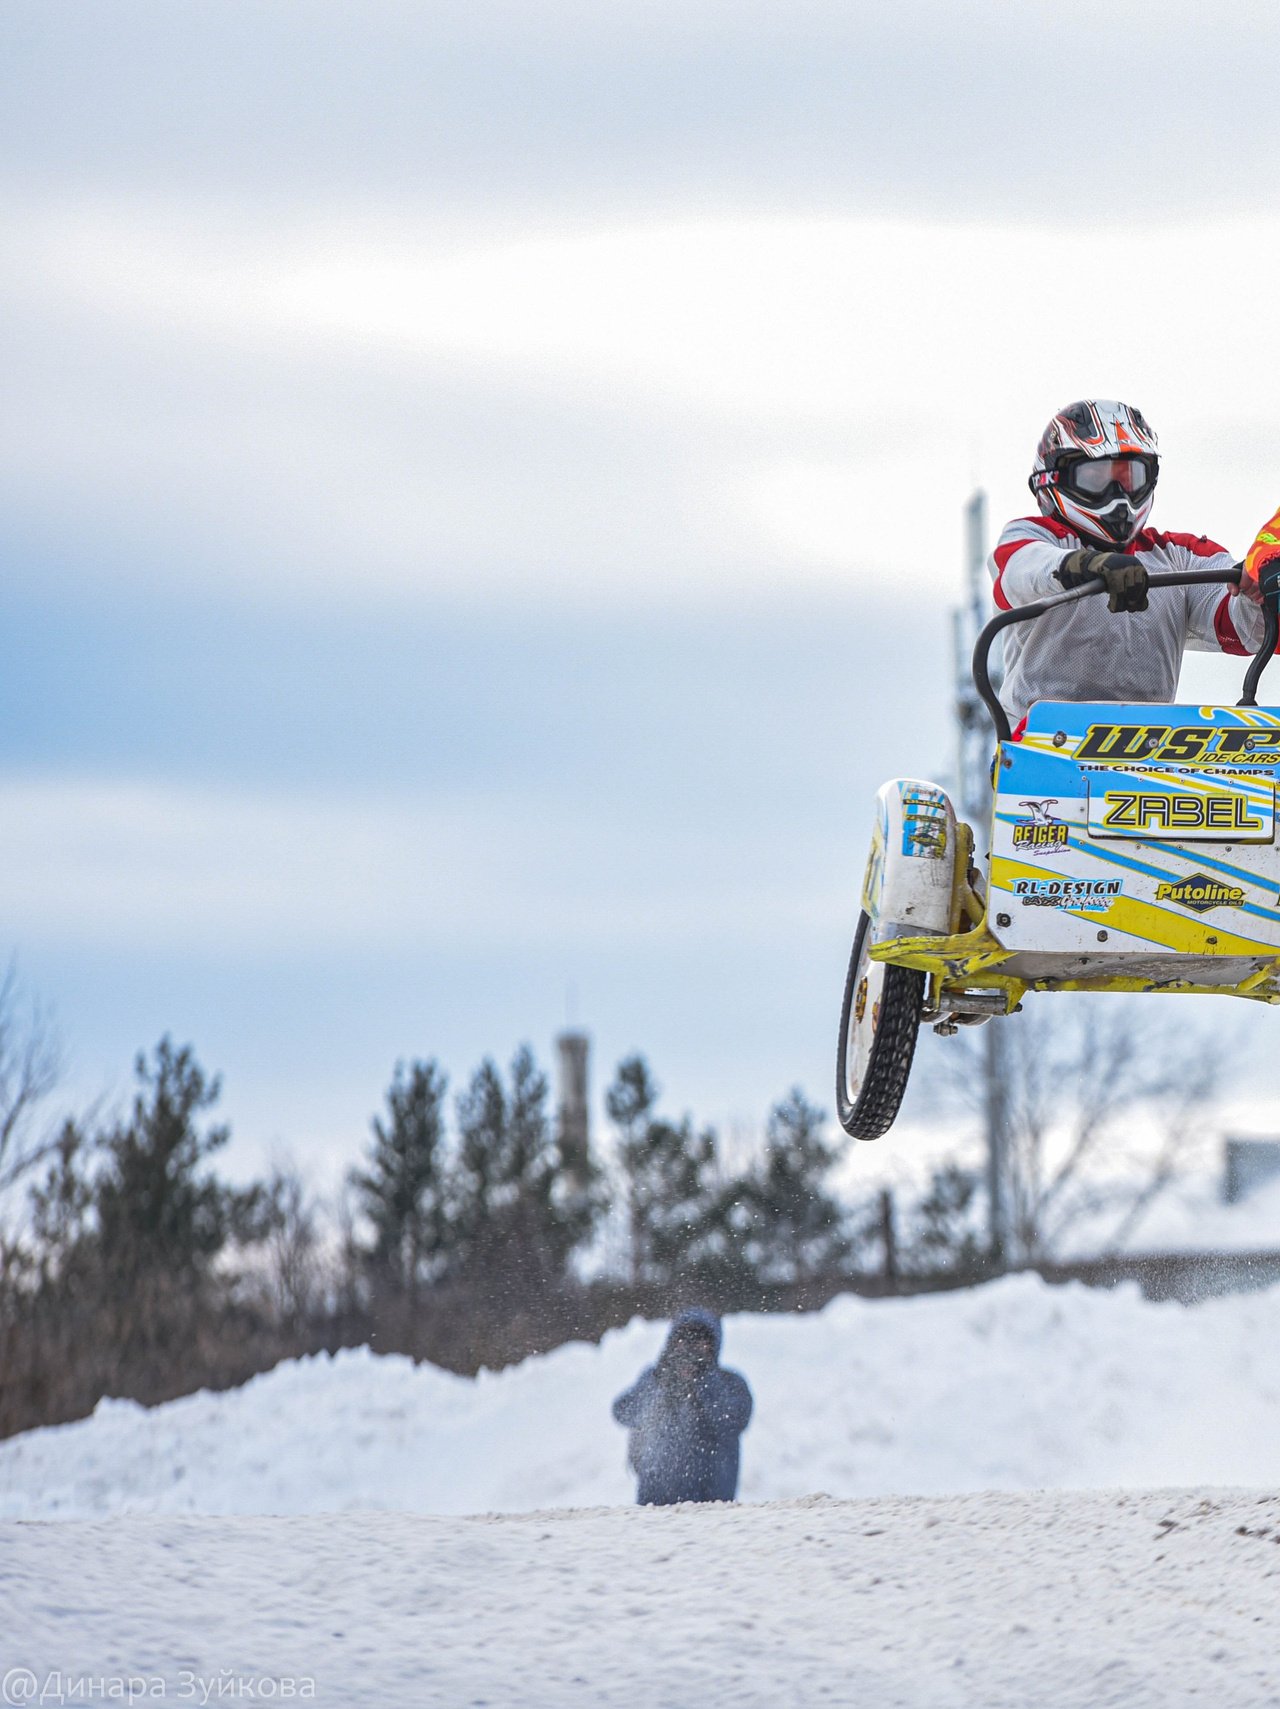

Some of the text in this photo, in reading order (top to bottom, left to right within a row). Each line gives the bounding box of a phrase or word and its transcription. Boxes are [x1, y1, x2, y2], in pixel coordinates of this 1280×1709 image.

[1112, 765, 1175, 774] CHOICE
[1203, 768, 1275, 776] CHAMPS
[1104, 793, 1260, 829] ZABEL
[1013, 826, 1067, 845] REIGER
[1015, 840, 1063, 852] Racing
[1015, 880, 1121, 895] RL-DESIGN
[1156, 884, 1243, 901] Putoline
